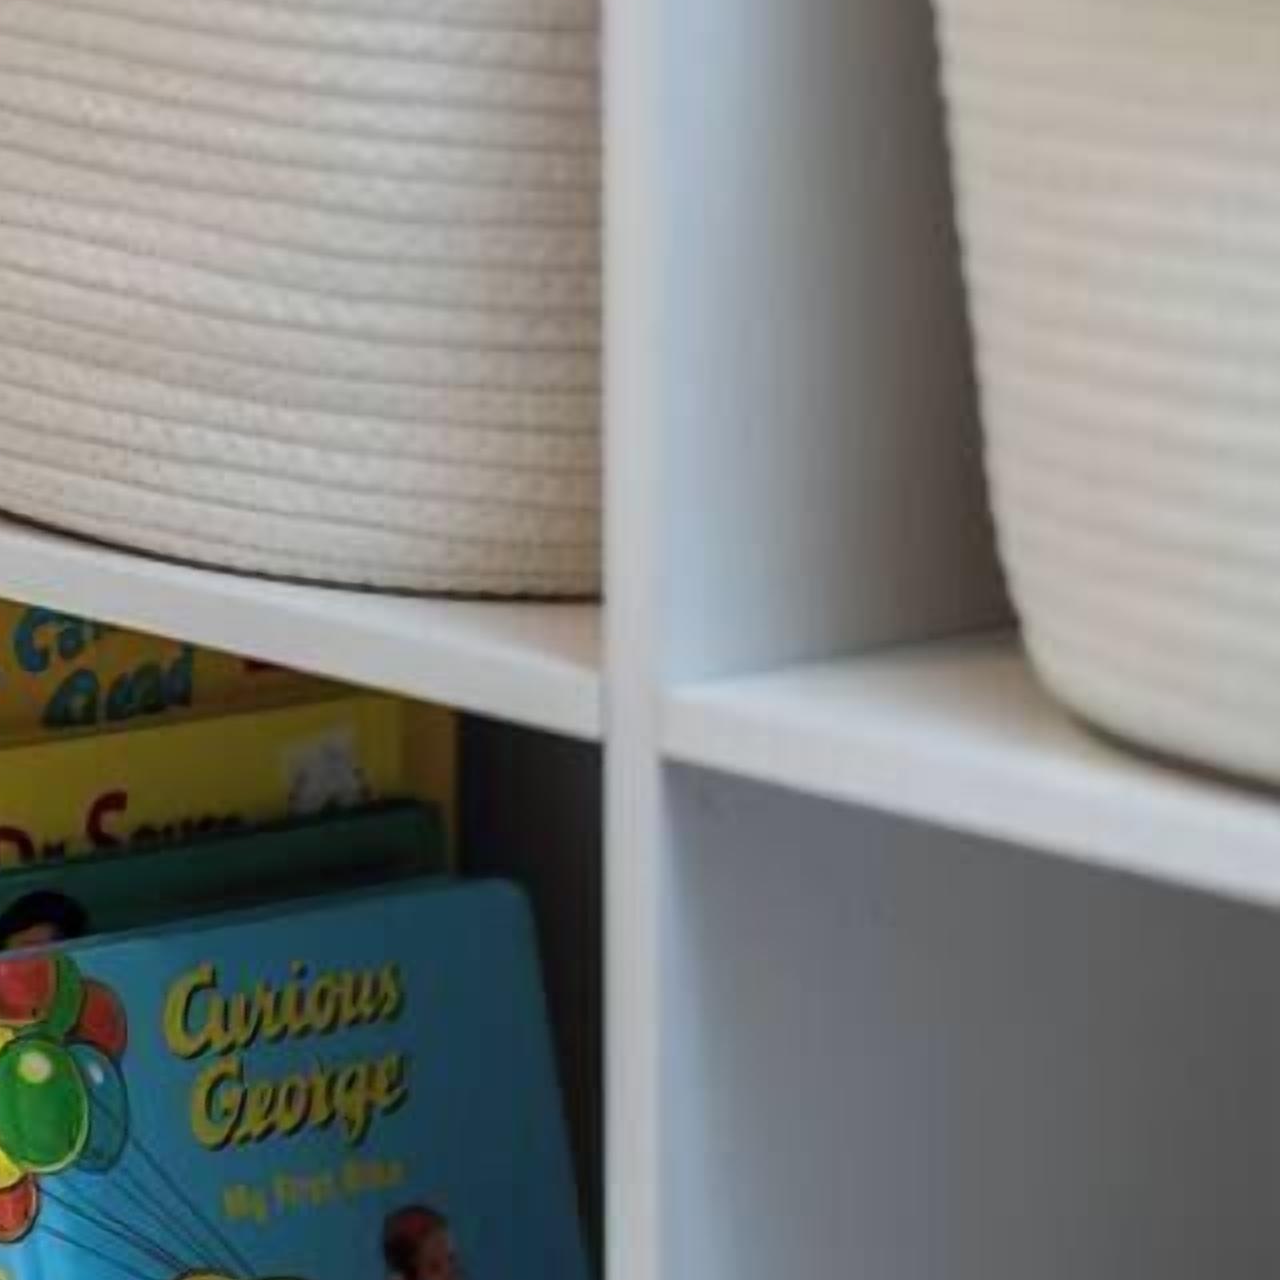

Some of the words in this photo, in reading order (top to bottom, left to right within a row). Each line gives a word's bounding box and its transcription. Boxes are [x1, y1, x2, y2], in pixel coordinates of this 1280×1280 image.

[14, 605, 106, 673] Ca
[163, 960, 404, 1059] Curious
[191, 1054, 409, 1151] George
